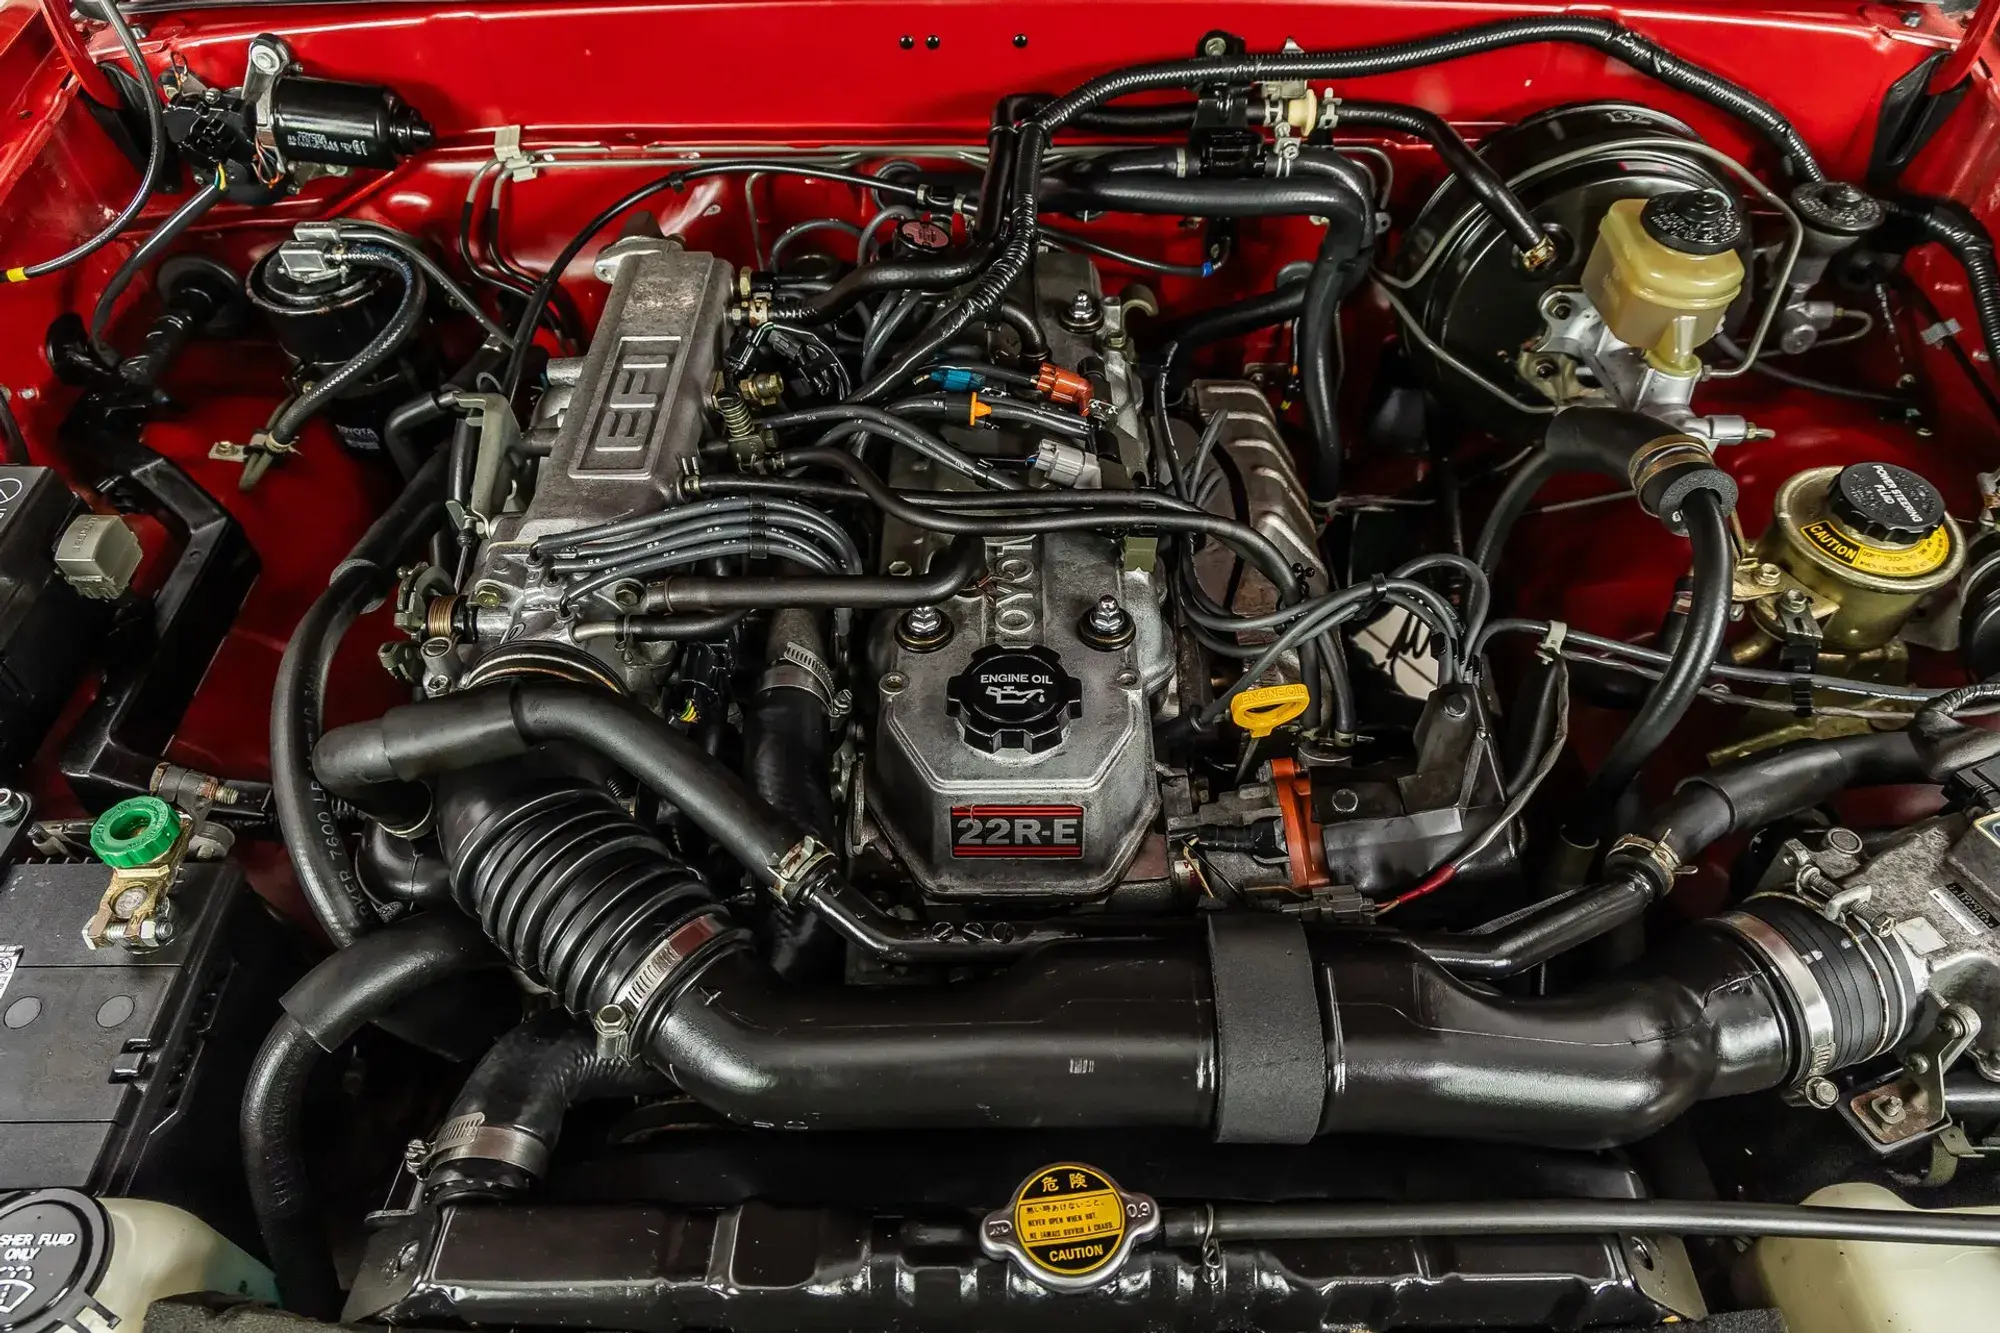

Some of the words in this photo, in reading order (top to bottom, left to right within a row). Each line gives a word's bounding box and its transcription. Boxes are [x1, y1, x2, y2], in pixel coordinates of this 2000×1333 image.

[594, 354, 670, 452] EFI
[1872, 464, 1897, 489] POWER
[1891, 487, 1923, 523] STEERING
[1873, 484, 1896, 506] FLUID
[1809, 524, 1858, 561] CAUTION
[980, 673, 1029, 684] ENGINE
[1031, 673, 1054, 685] OIL
[1241, 687, 1284, 705] ENGINE
[1286, 683, 1306, 698] OIL
[956, 818, 1078, 845] 22R-E
[1041, 1172, 1088, 1193] 危険
[0, 1233, 35, 1247] SHER
[37, 1233, 76, 1247] FLUID
[4, 1247, 41, 1261] ONLY
[1049, 1244, 1104, 1263] CAUTION
